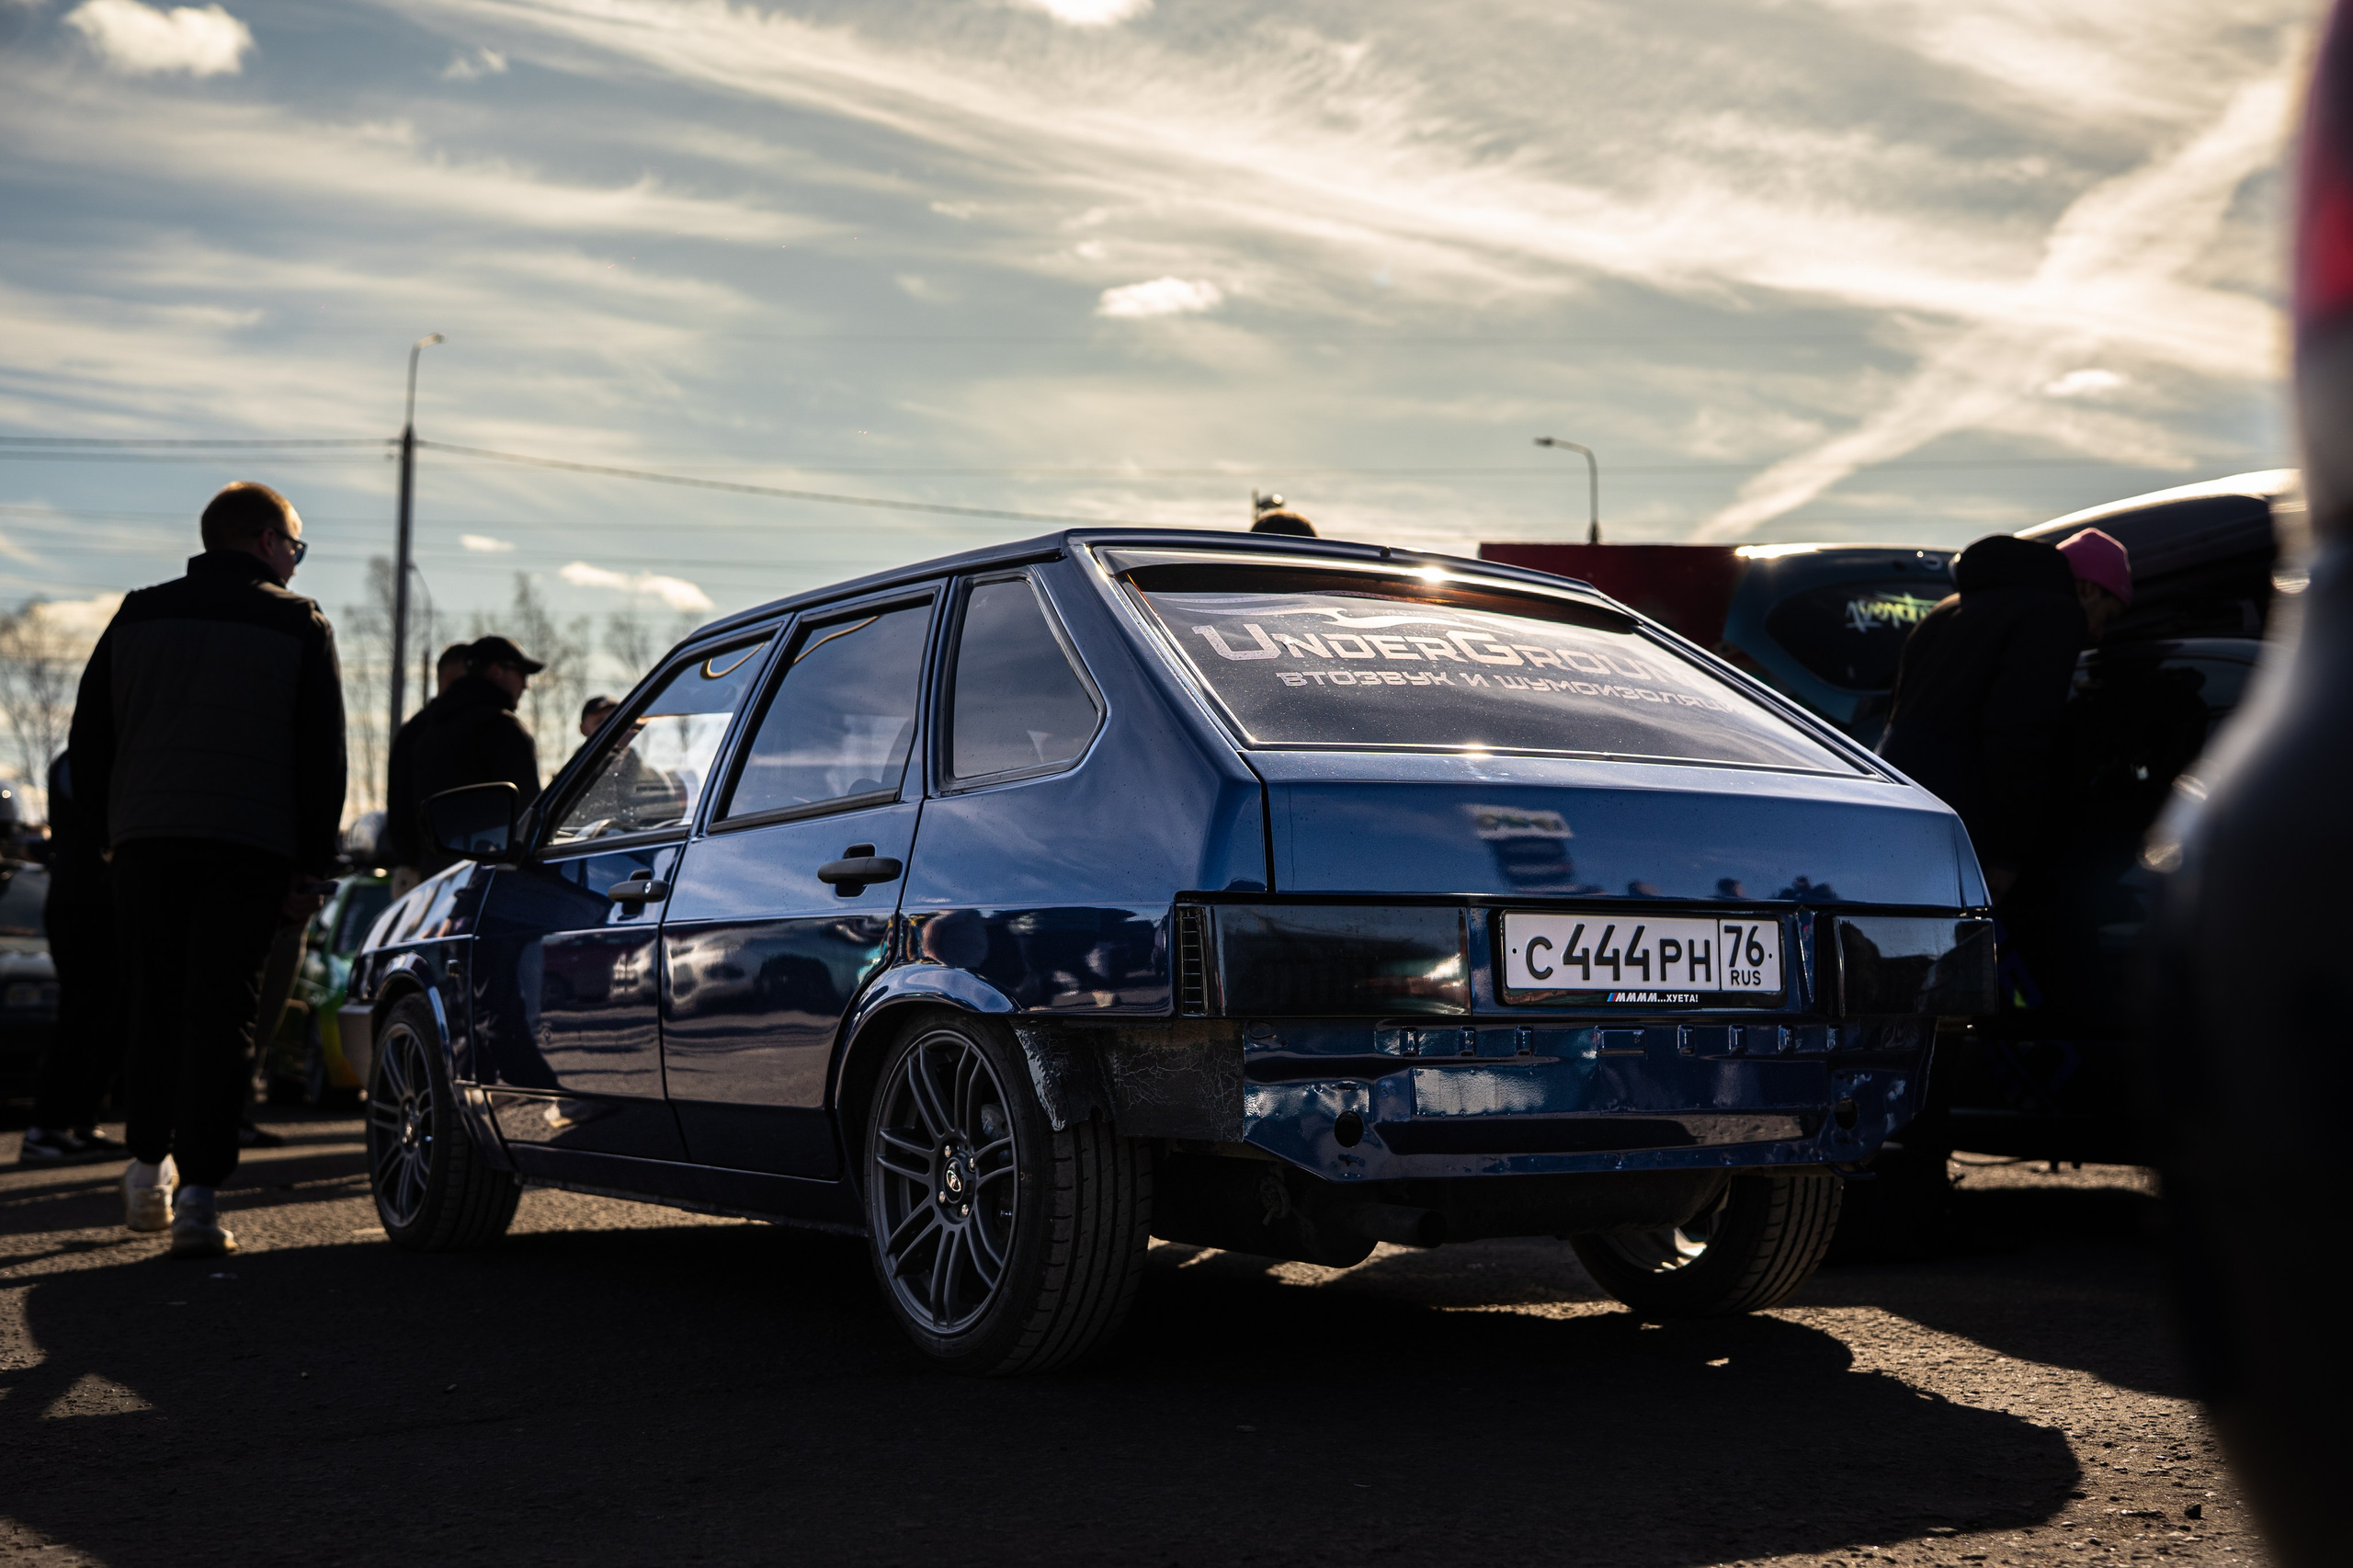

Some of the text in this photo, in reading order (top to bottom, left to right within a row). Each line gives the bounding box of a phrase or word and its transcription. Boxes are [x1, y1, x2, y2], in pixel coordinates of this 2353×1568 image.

[1191, 623, 1691, 684] UNDERGROUN
[1460, 673, 1490, 687] И
[1493, 675, 1740, 714] ШУМОИЗОЛЯЦИ
[1526, 924, 1765, 982] С444РН 76
[1731, 970, 1761, 985] RUS
